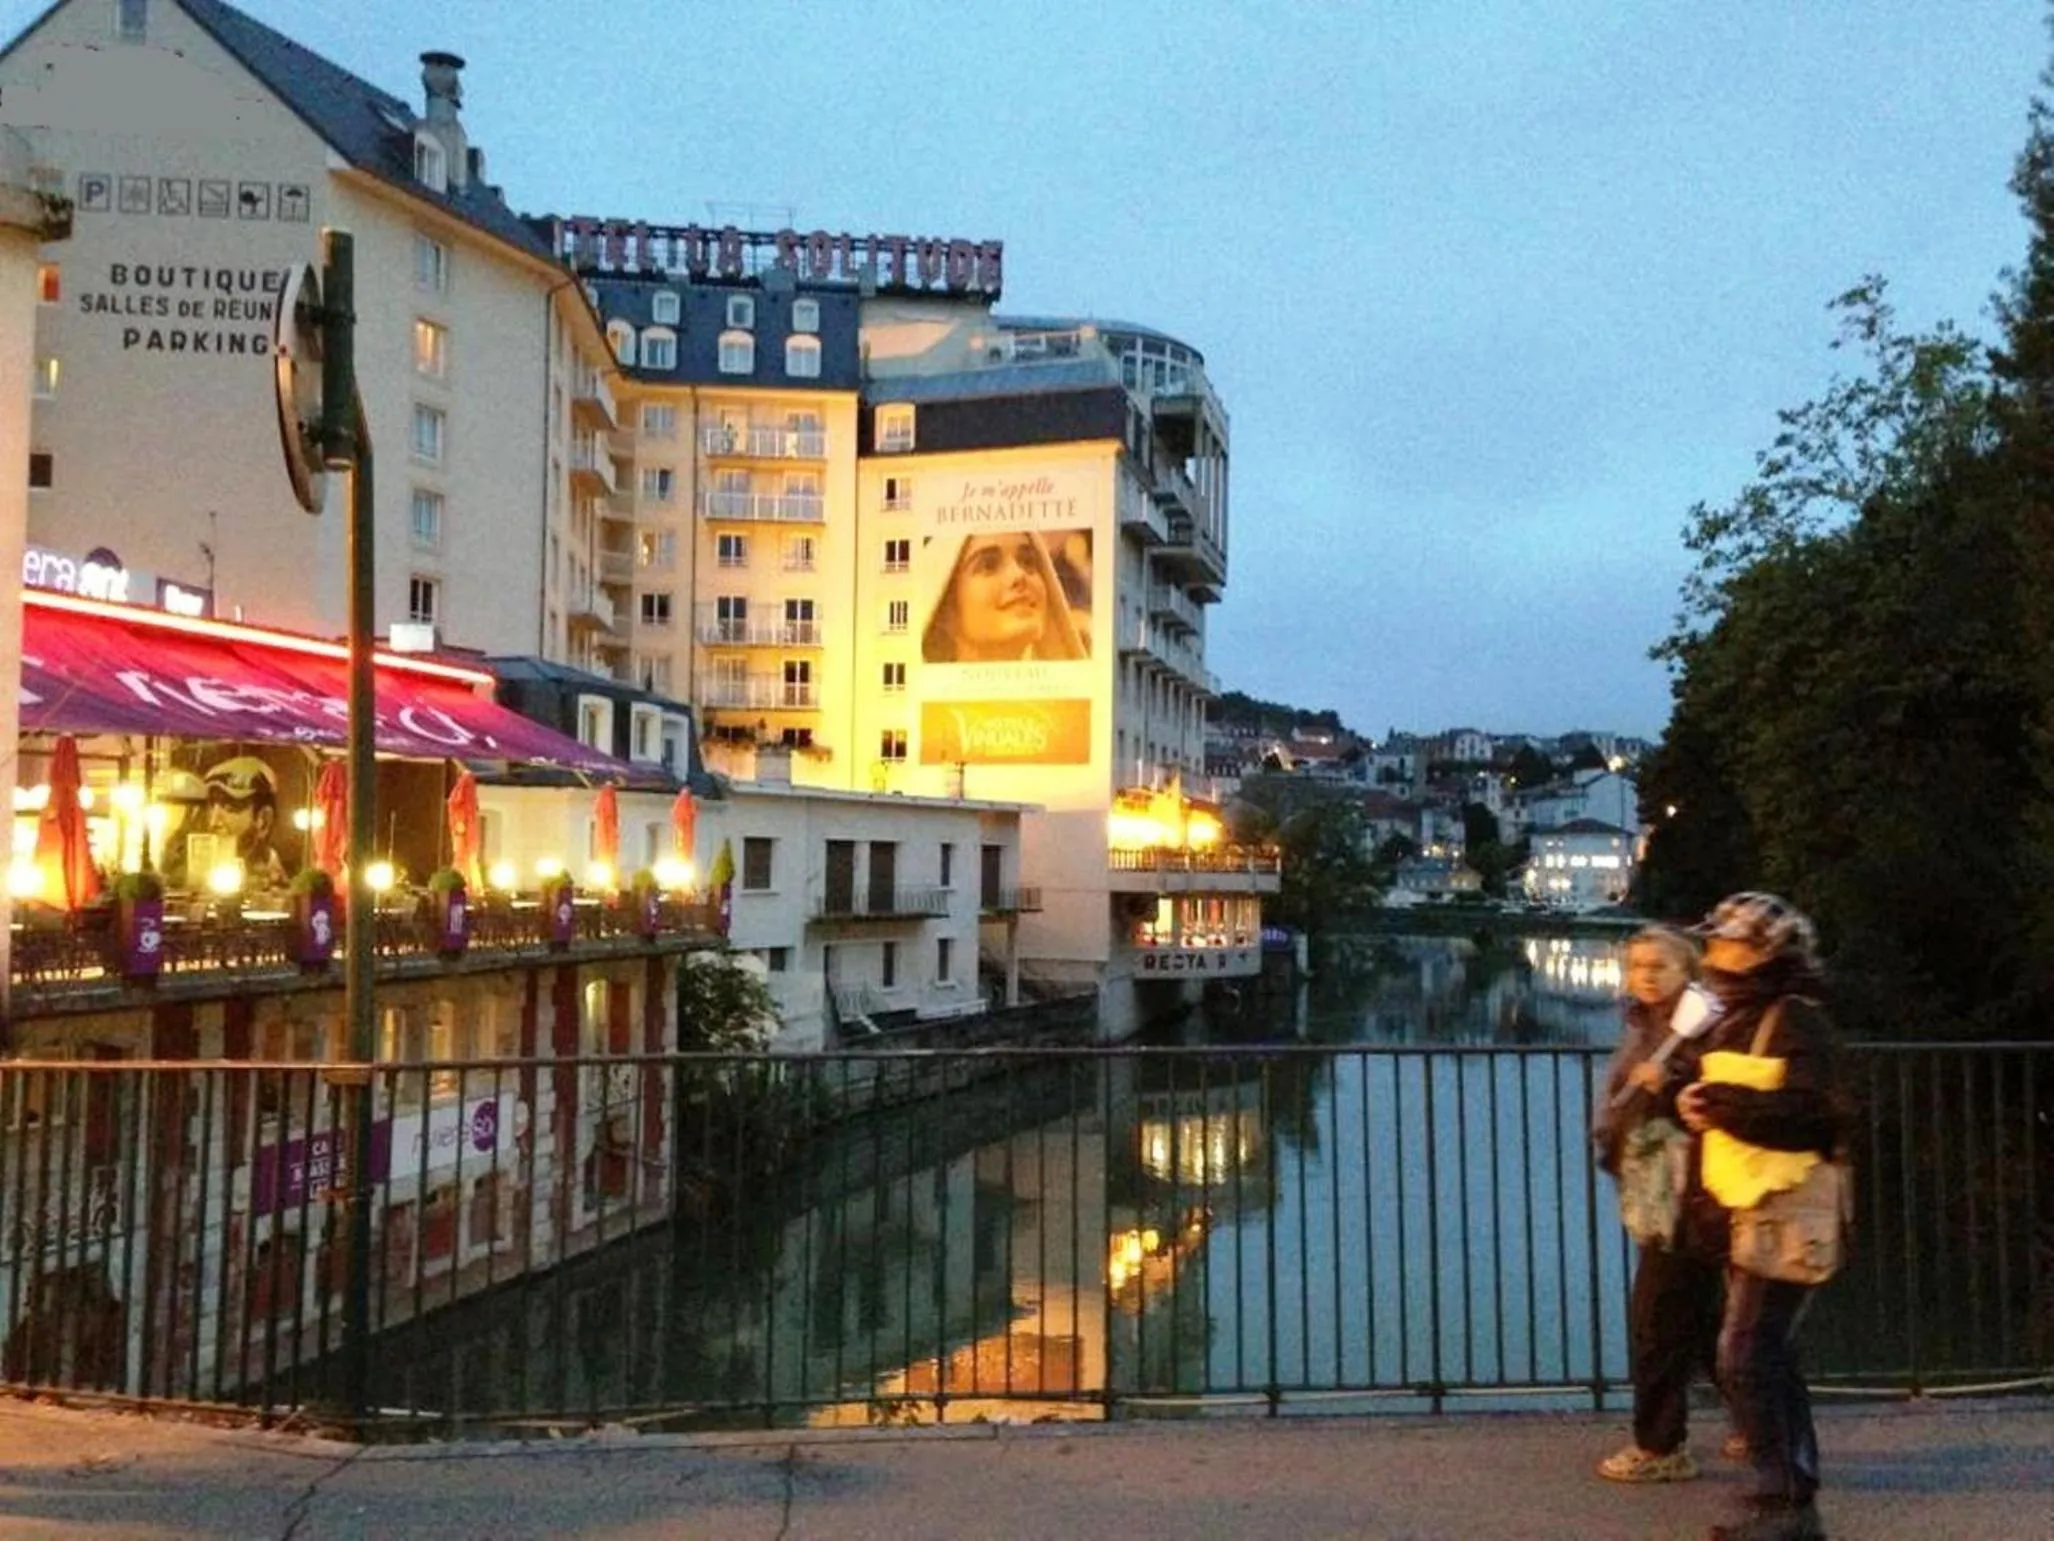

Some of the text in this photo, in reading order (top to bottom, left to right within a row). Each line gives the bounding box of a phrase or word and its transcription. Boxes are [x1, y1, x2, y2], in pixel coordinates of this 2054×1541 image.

[776, 227, 1004, 292] SOLITUDE
[110, 263, 280, 294] BOUTIQUE
[80, 293, 169, 317] SALLES
[213, 299, 273, 322] REUN
[123, 327, 268, 356] PARKING
[936, 496, 1078, 525] BERNADETTE
[22, 549, 77, 594] era
